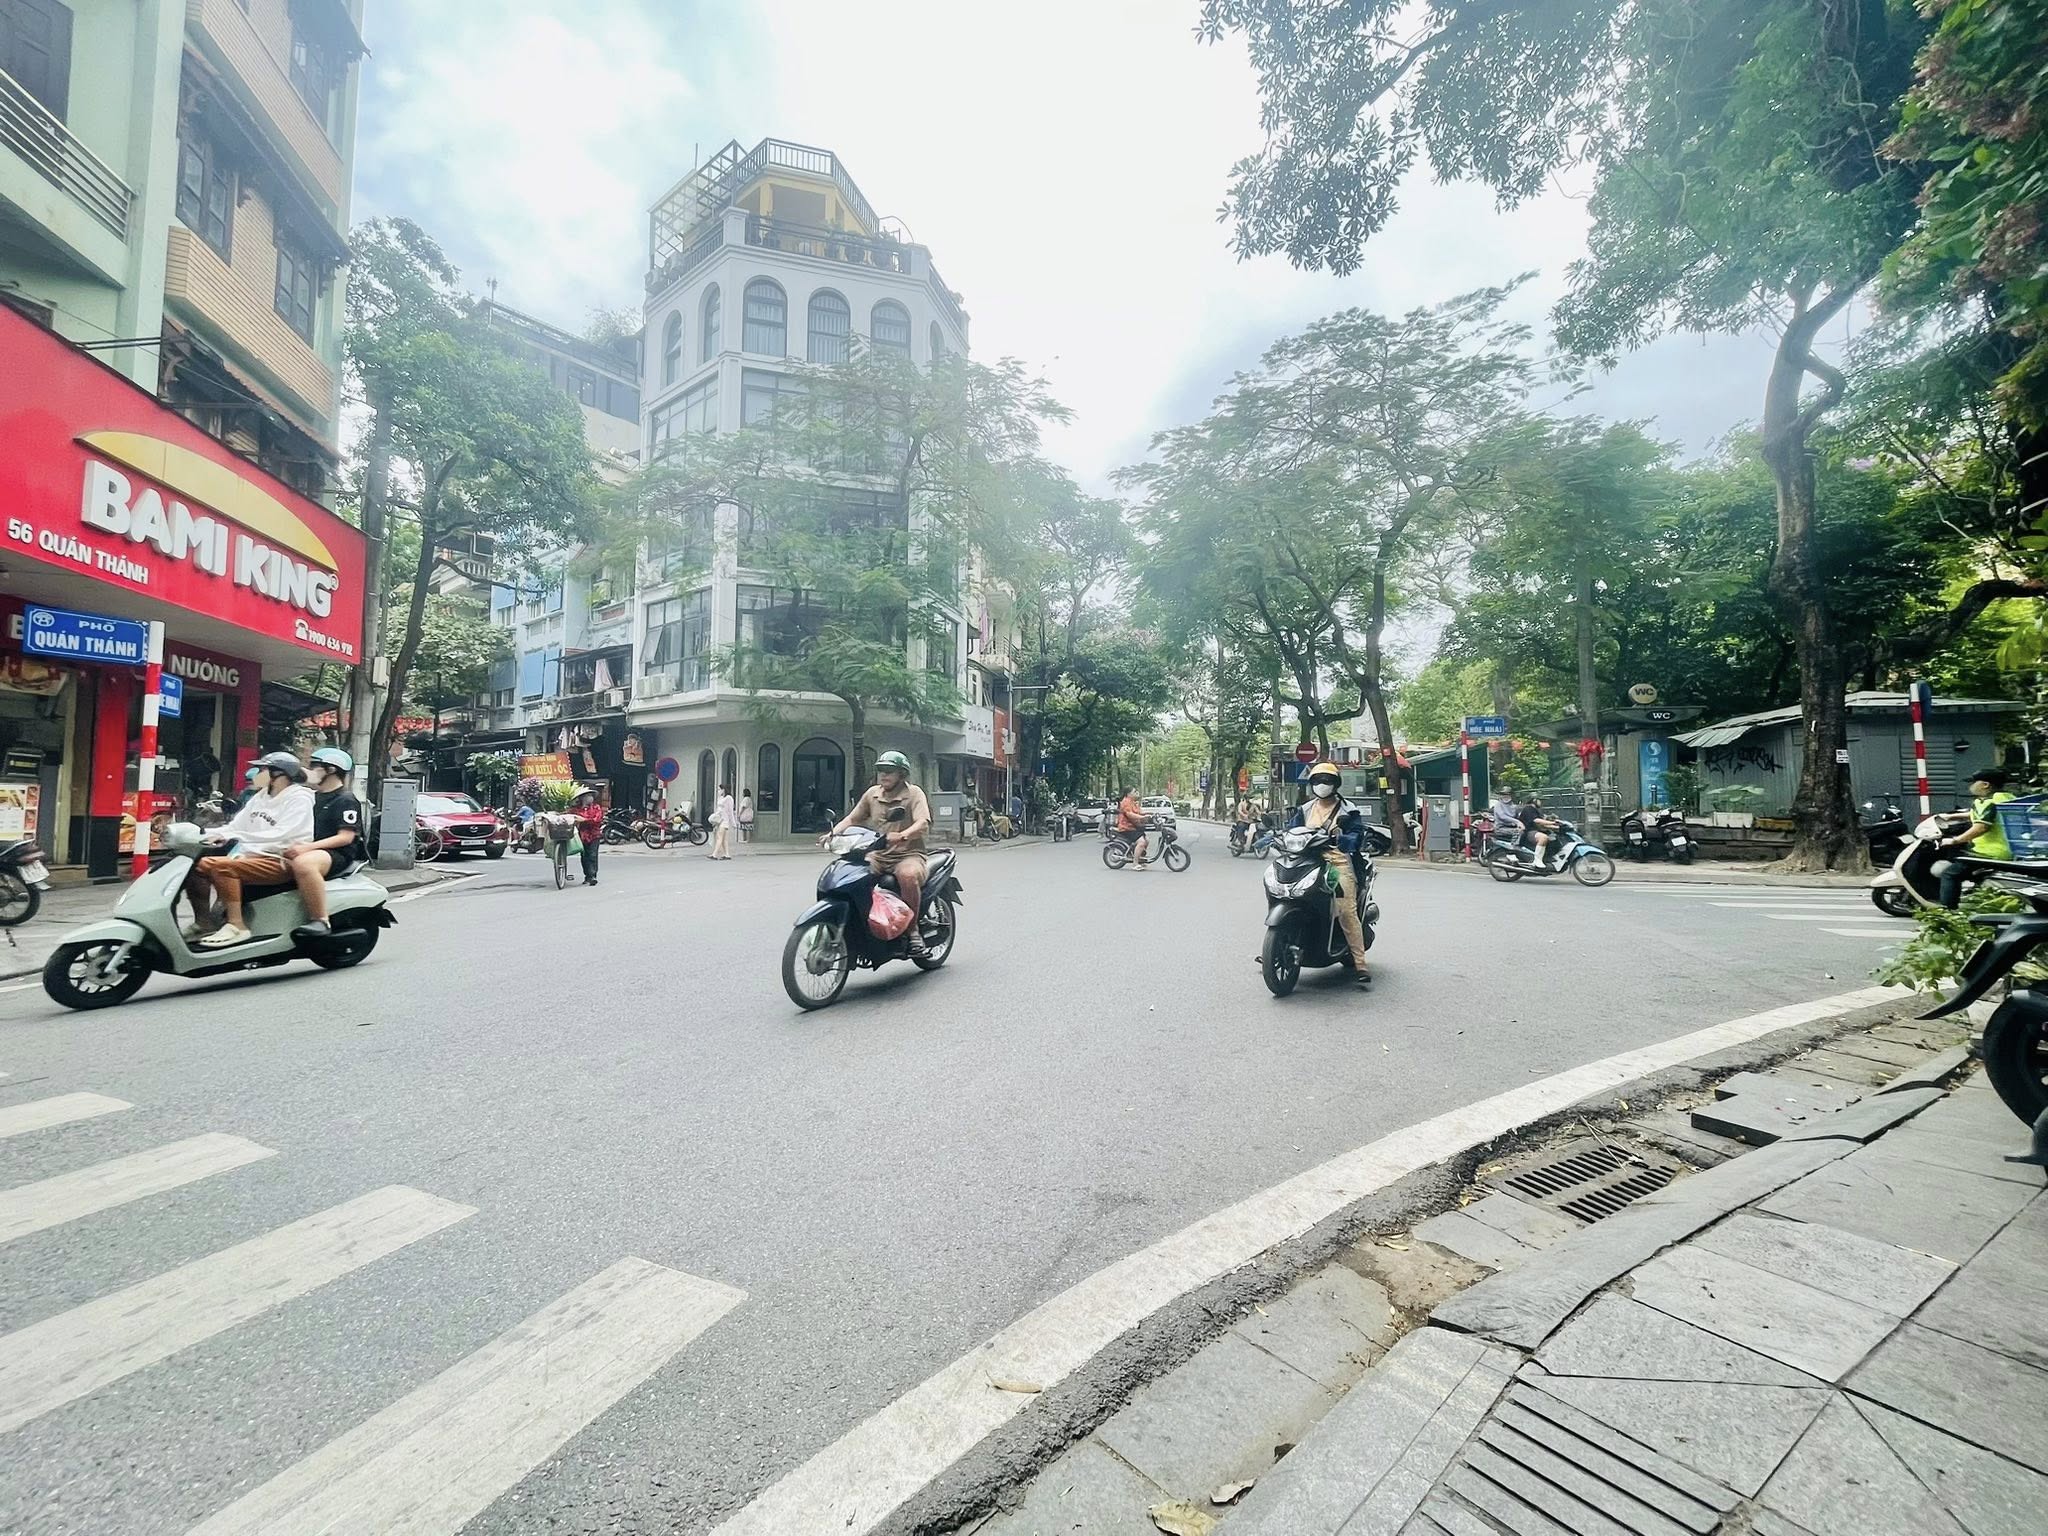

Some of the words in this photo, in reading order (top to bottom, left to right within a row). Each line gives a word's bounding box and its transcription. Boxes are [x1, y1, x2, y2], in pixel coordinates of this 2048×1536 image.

[81, 460, 228, 577] BAMI
[233, 534, 332, 618] KING
[8, 518, 33, 543] 56
[39, 530, 92, 564] QUÁN
[96, 550, 149, 585] THÁNH
[79, 619, 117, 633] PHỐ
[34, 630, 80, 651] QUÁN
[85, 636, 137, 657] THÁNH
[1634, 688, 1654, 696] WC
[1652, 712, 1671, 720] WC
